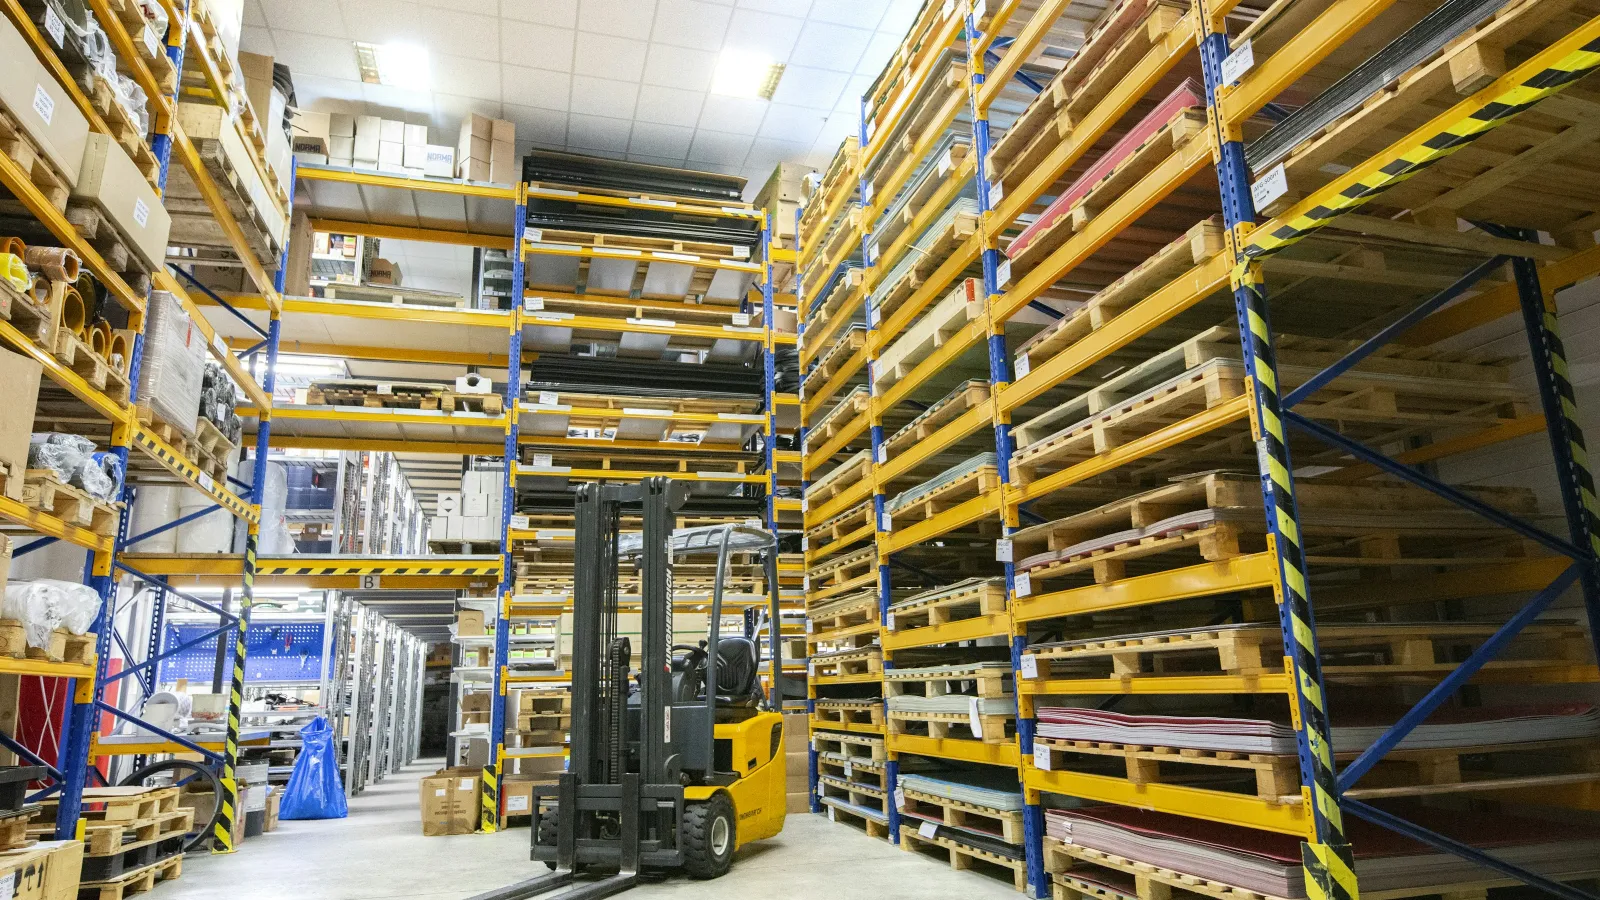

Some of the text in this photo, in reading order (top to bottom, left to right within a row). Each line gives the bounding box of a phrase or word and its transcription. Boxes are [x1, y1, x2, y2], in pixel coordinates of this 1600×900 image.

[295, 143, 320, 153] NORMA
[427, 152, 452, 164] NORMA
[364, 575, 374, 589] B
[663, 568, 673, 674] JUNGHEINRICH
